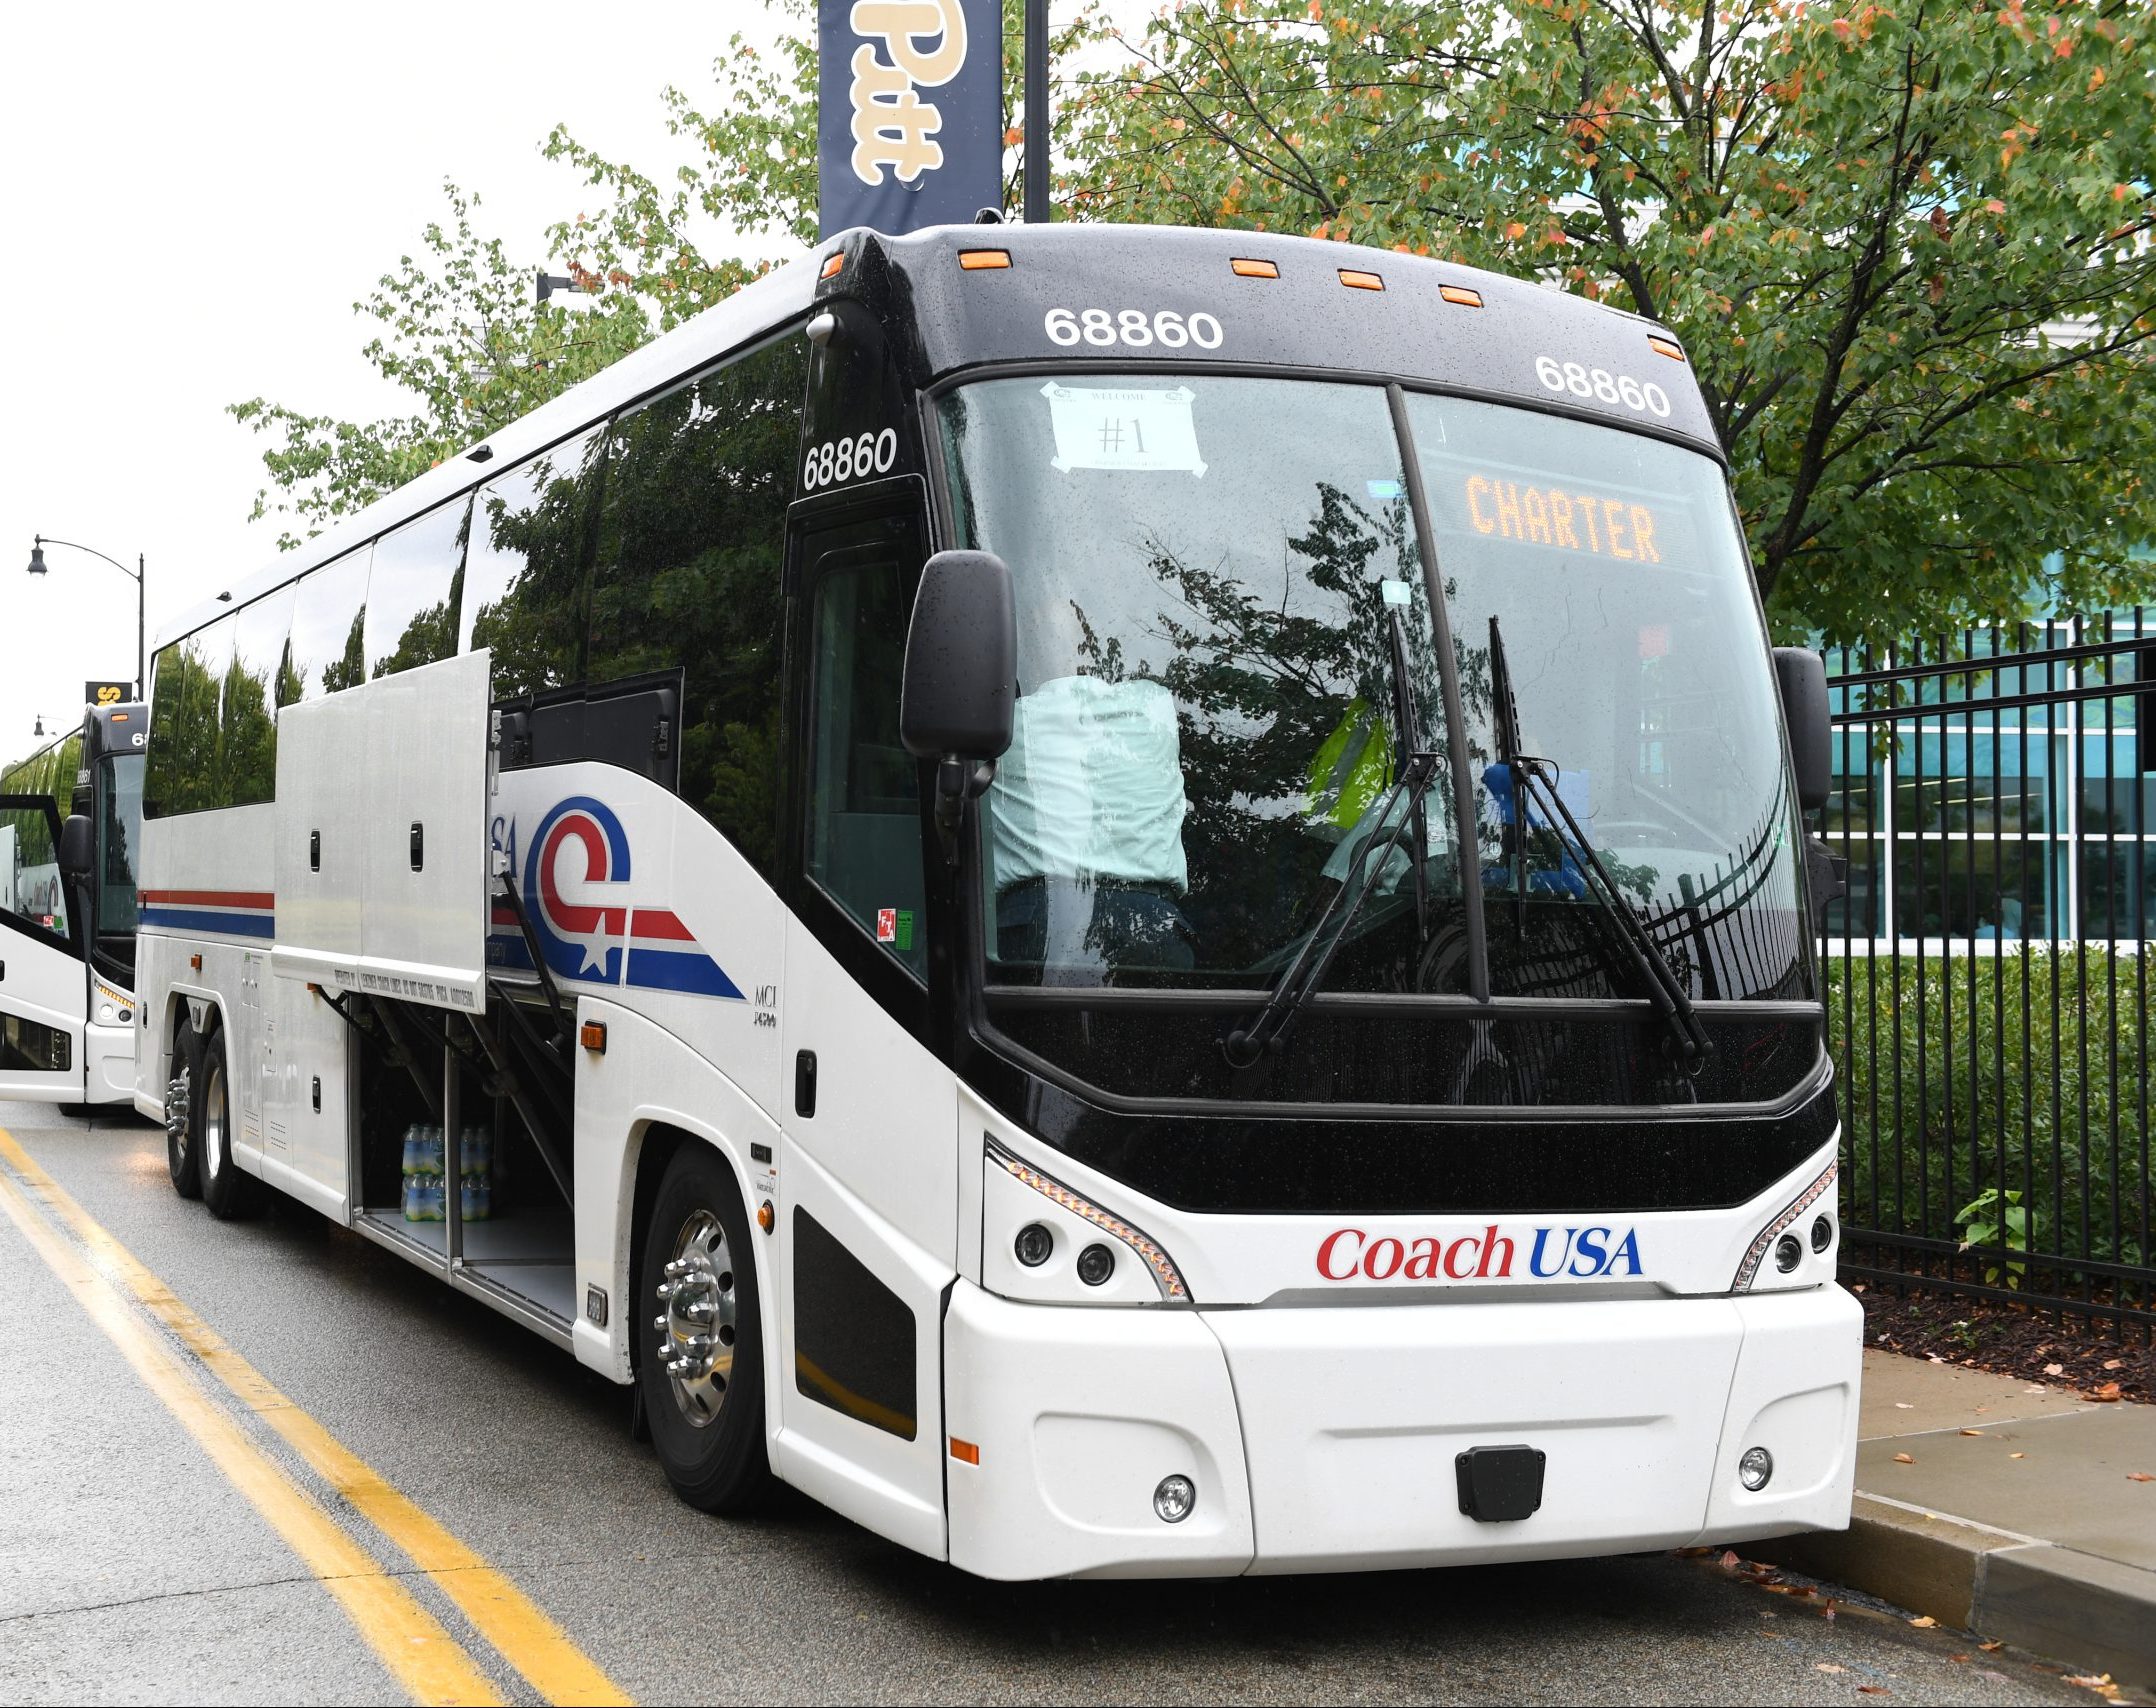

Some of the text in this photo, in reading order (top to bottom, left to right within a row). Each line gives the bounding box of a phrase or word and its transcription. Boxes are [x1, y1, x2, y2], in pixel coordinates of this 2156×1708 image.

[850, 0, 968, 186] Pitt
[1044, 308, 1224, 349] 68860
[1091, 391, 1145, 401] WELCOME
[1535, 356, 1671, 418] 68860
[804, 428, 897, 491] 68860
[1098, 417, 1149, 453] #1
[1466, 475, 1661, 563] CHARTER
[754, 985, 777, 1008] MCI
[1316, 1224, 1645, 1281] Coach USA
